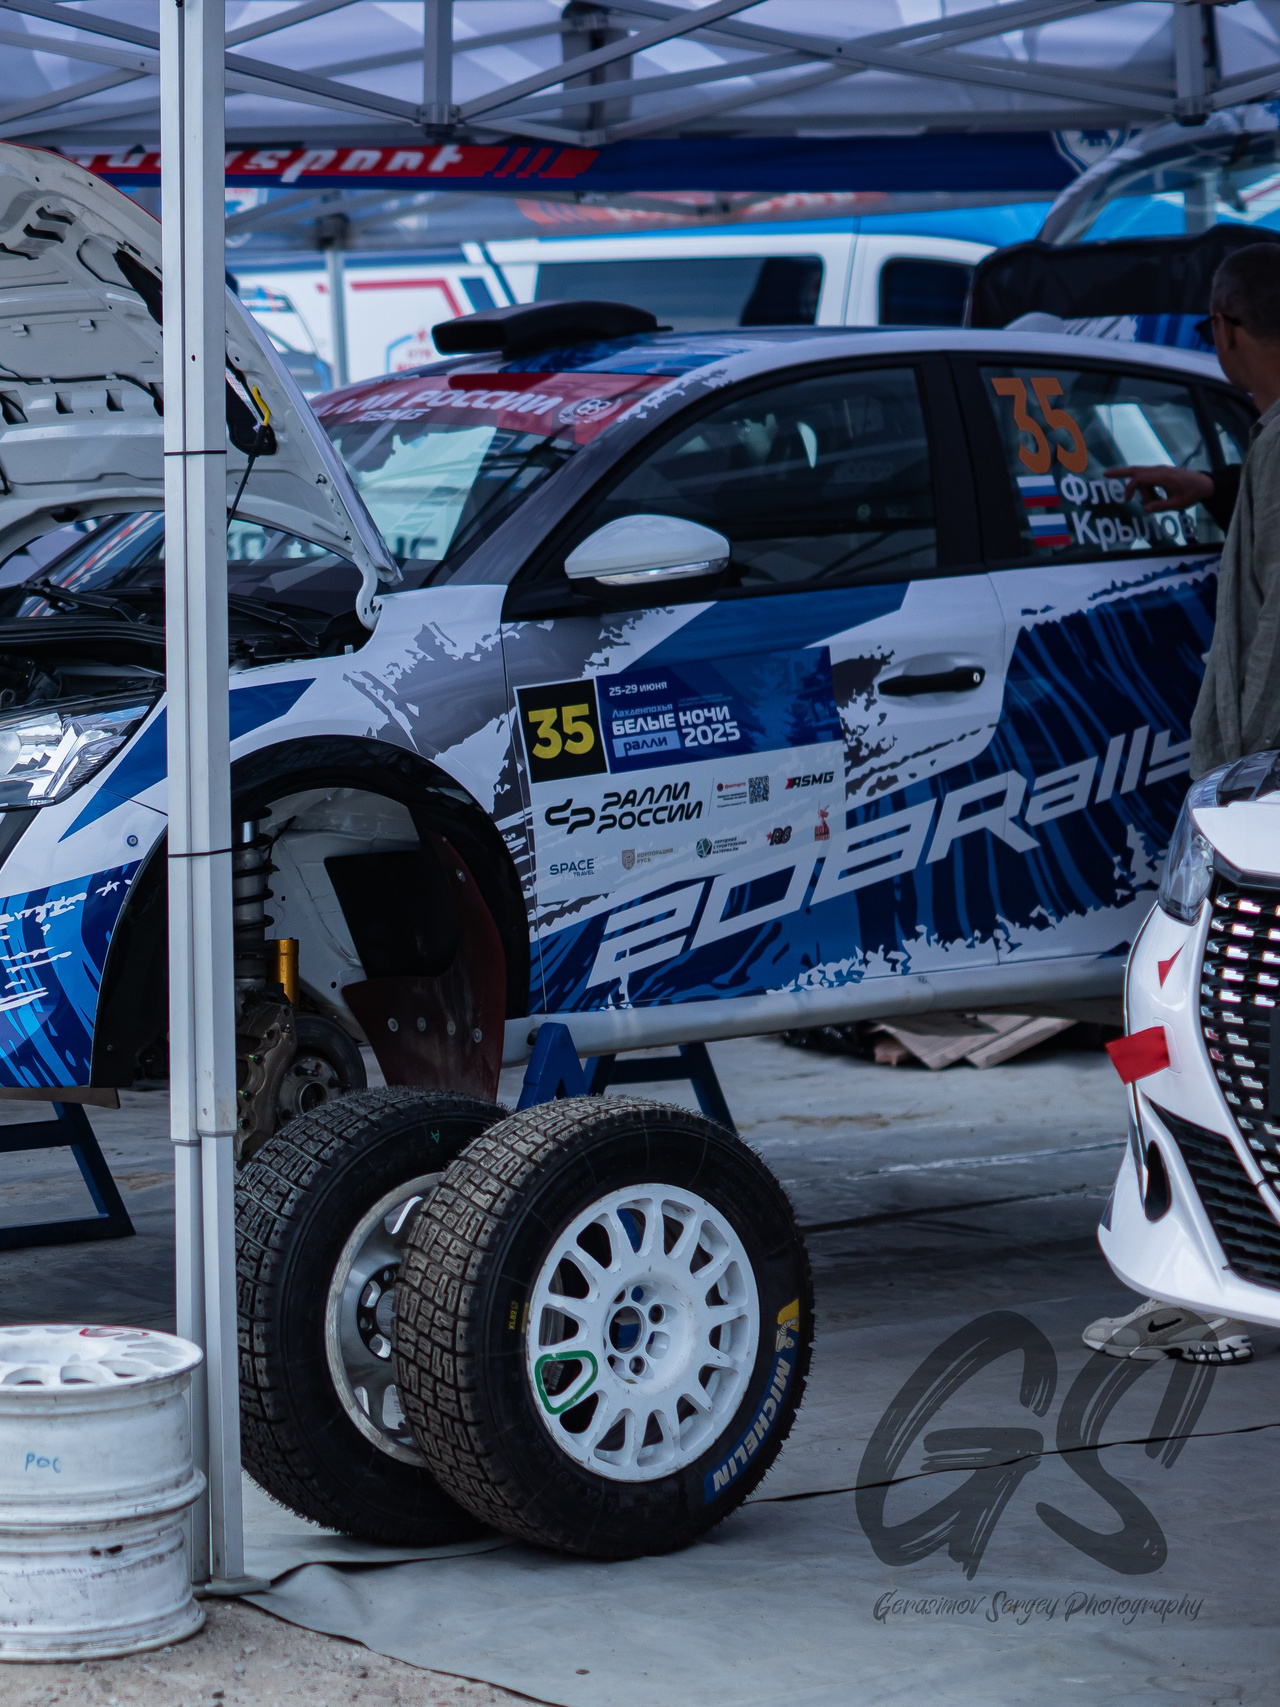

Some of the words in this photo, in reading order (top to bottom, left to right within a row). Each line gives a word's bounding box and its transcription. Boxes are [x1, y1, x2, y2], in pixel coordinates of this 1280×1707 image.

[404, 389, 564, 416] РОССИИ
[991, 377, 1089, 474] 35
[609, 685, 637, 697] 25-29
[528, 703, 595, 759] 35
[612, 713, 676, 736] БЕЛЫЕ
[679, 706, 731, 726] НОЧИ
[682, 721, 741, 748] 2025
[623, 734, 668, 756] ралли
[601, 781, 691, 812] РАЛЛИ
[596, 800, 704, 834] РОССИИ
[549, 858, 595, 876] SPACE
[573, 869, 596, 878] TRAVEL
[713, 1357, 791, 1492] MICHELIN
